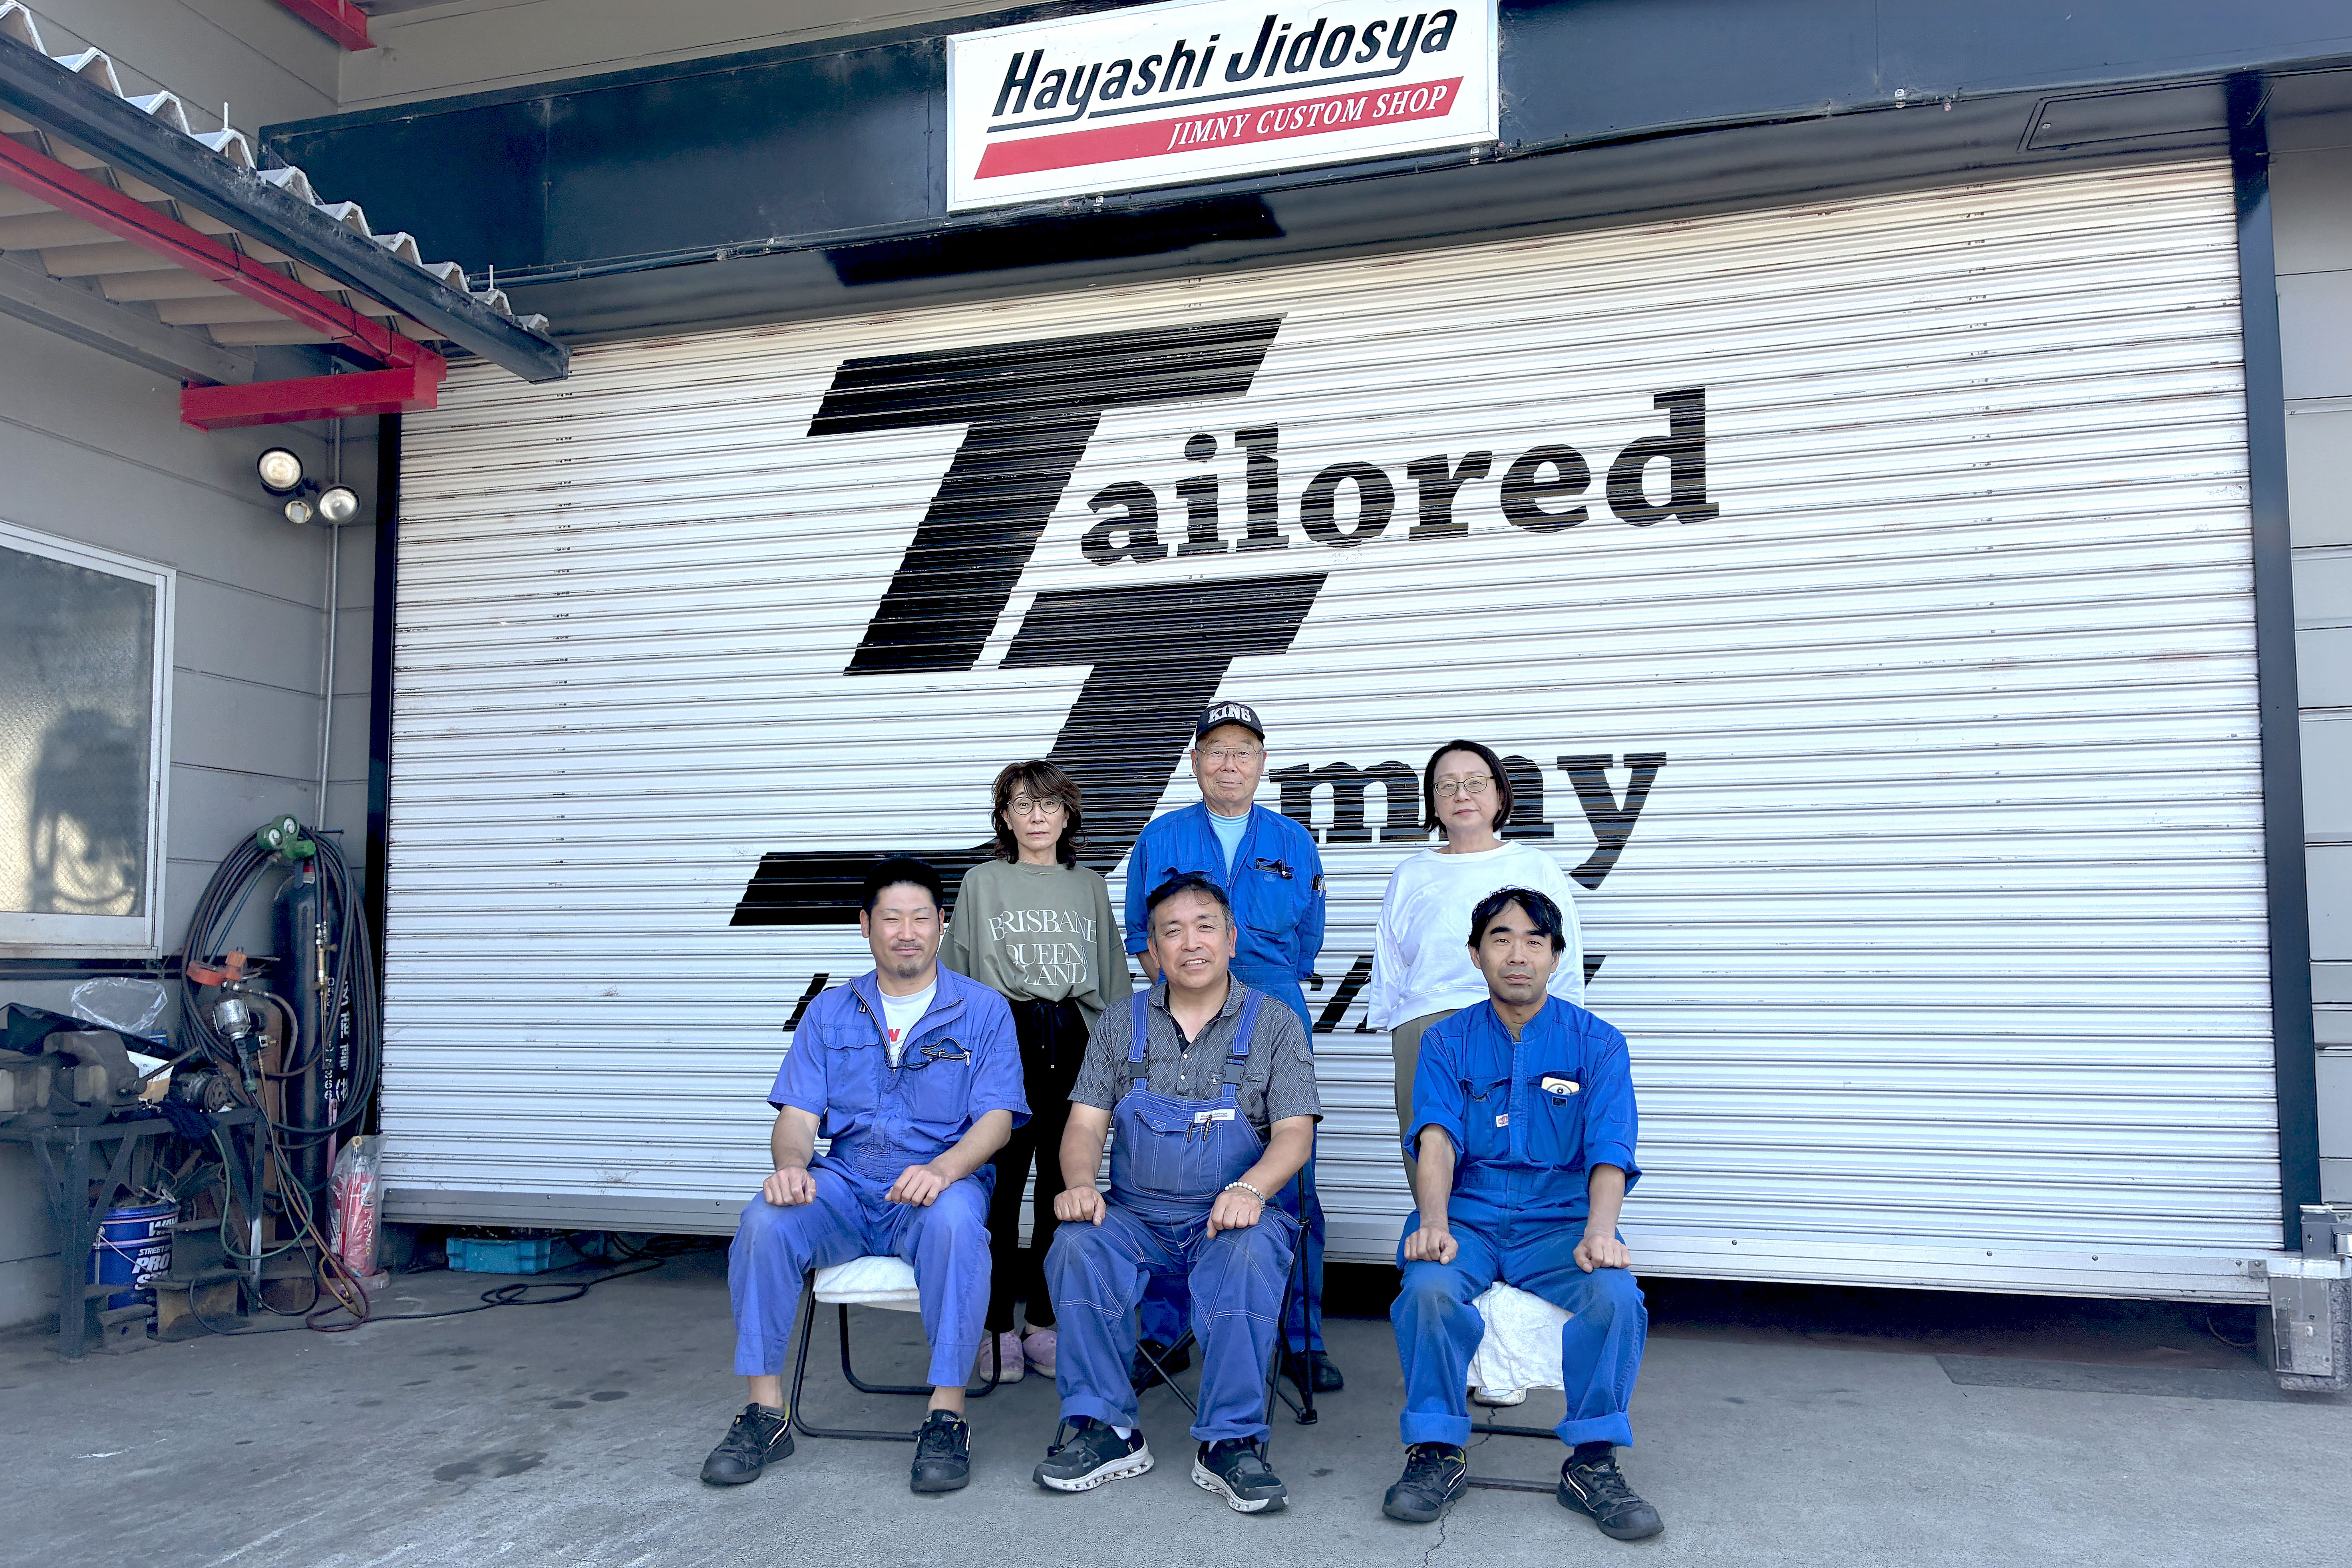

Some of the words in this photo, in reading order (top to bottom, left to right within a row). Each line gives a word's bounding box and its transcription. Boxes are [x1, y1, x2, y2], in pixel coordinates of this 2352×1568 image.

[992, 34, 1221, 118] Hayashi
[1226, 9, 1458, 82] Jidosya
[1167, 113, 1252, 151] JIMNY
[1257, 97, 1368, 135] CUSTOM
[1373, 85, 1447, 119] SHOP
[988, 909, 1097, 944] BRISBANE
[132, 1253, 170, 1274] PRO
